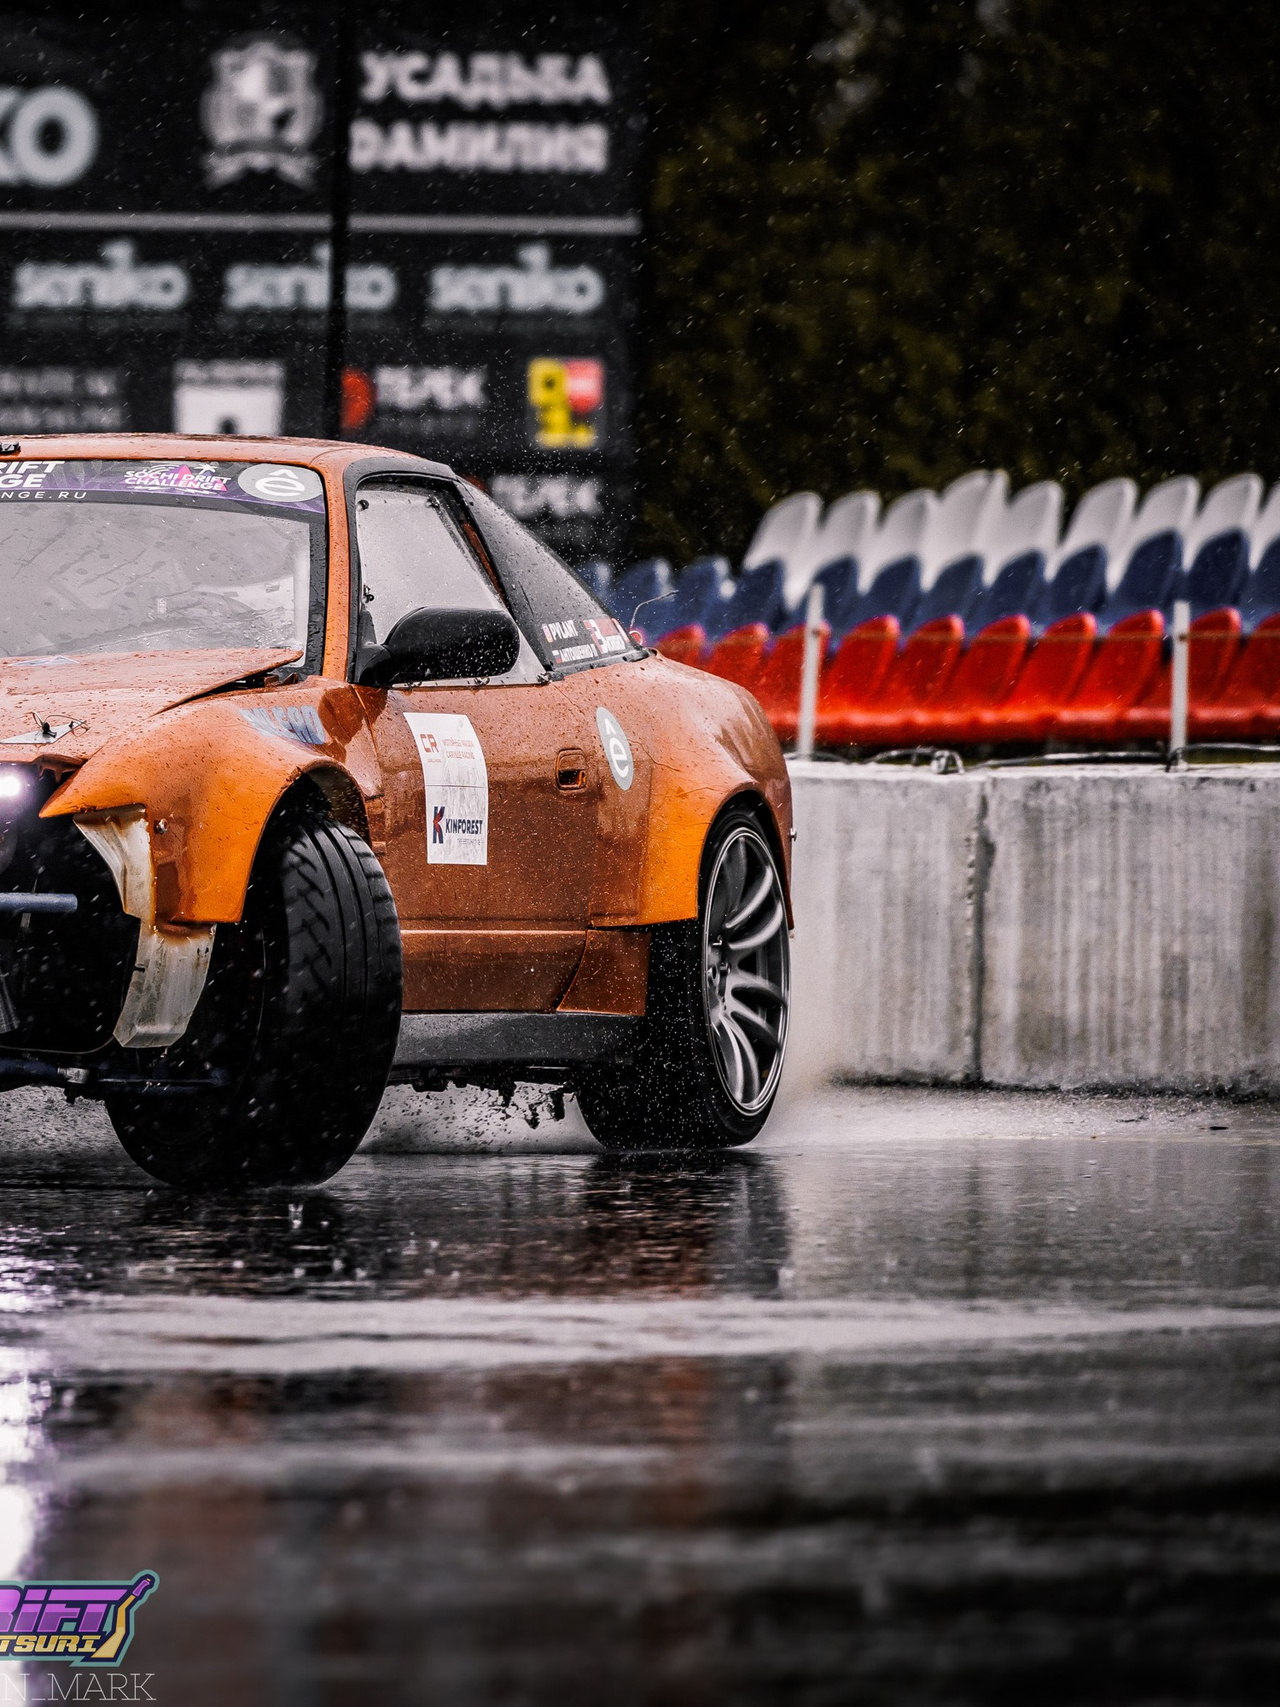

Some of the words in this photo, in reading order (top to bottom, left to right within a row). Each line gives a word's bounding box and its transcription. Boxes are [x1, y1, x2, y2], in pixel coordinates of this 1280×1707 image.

[124, 471, 179, 481] SOCHI
[182, 473, 231, 484] DRIFT
[124, 477, 225, 491] CHALLENGE
[420, 734, 439, 752] CR
[446, 819, 483, 834] KINFOREST
